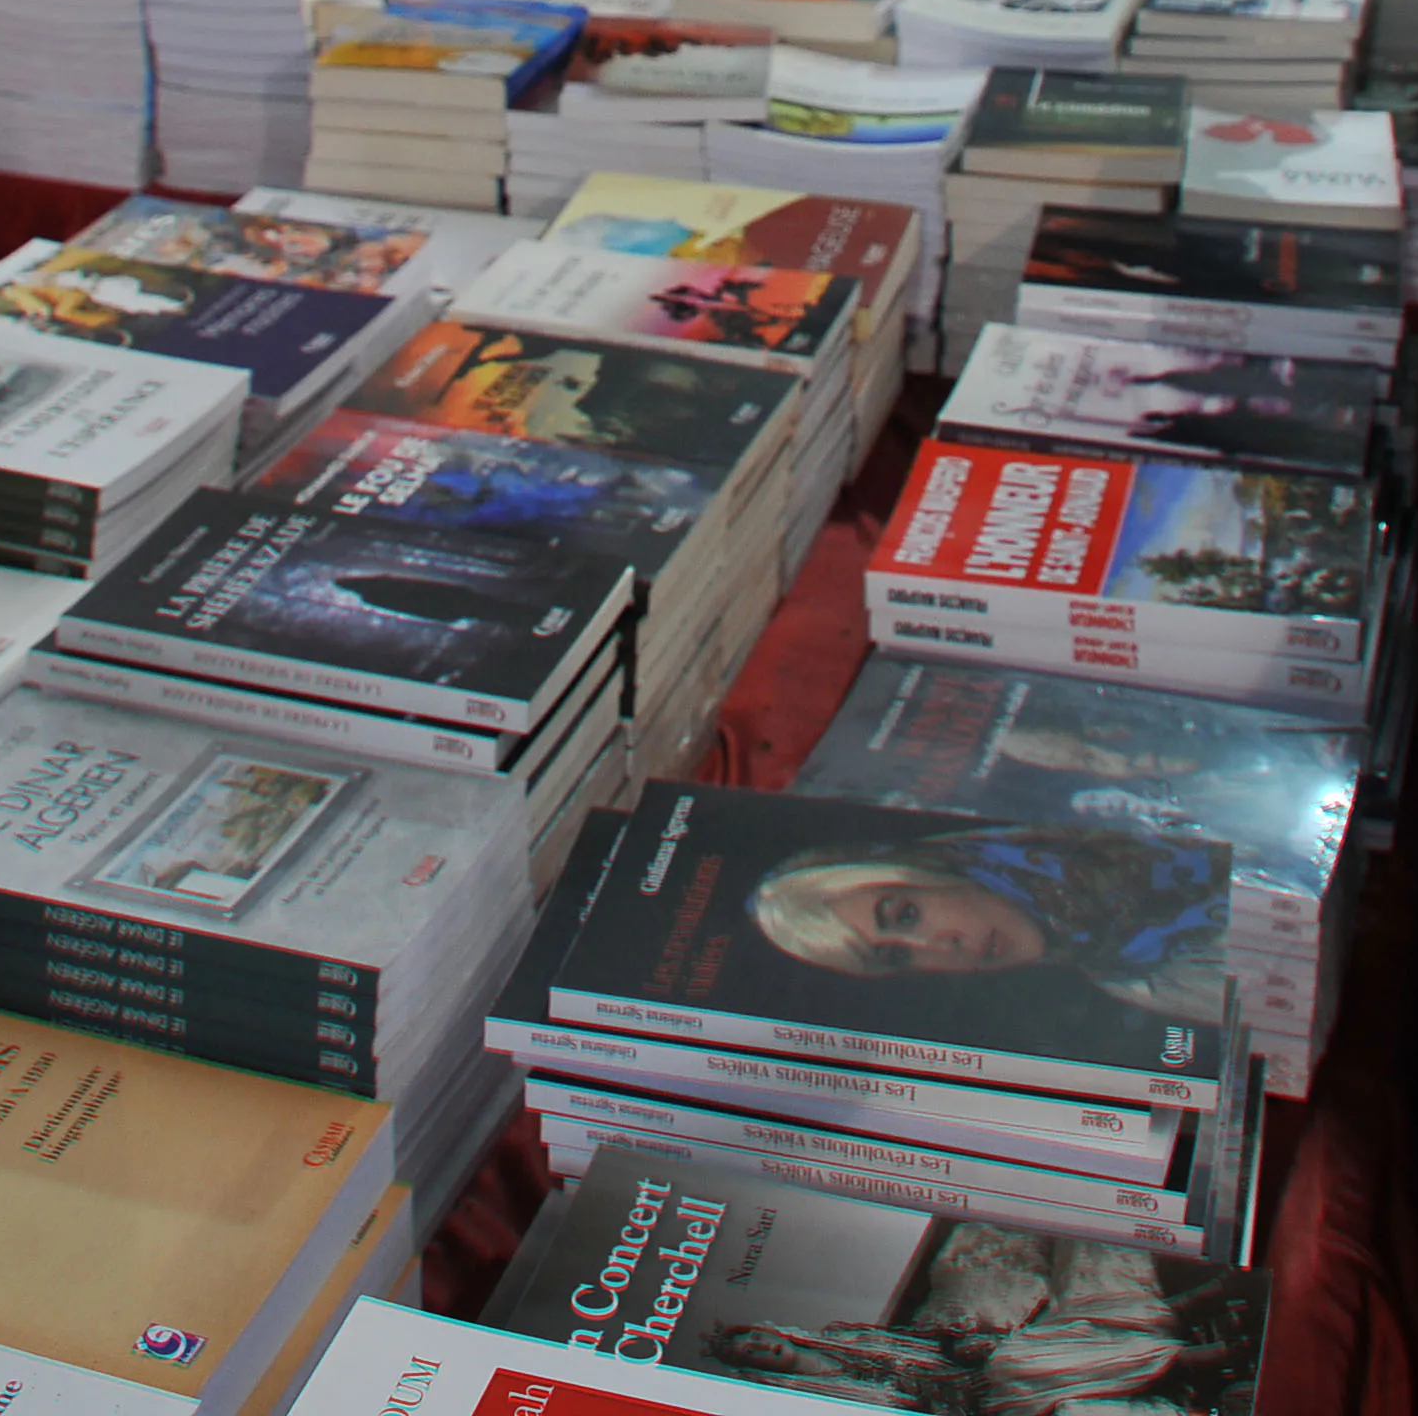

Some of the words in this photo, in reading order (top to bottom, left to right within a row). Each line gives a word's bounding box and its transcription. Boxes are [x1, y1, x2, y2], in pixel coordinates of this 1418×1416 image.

[963, 462, 1063, 579] L'HONNEUR
[773, 1024, 836, 1051] violées
[842, 1035, 949, 1066] révolutions
[706, 1054, 770, 1081] violées
[953, 1051, 986, 1072] Les
[776, 1065, 882, 1096] révolutions
[884, 1082, 918, 1103] Les
[21, 1065, 102, 1153] Dictionnaire
[38, 1070, 124, 1164] biographique
[303, 1121, 347, 1167] CASBAH
[743, 1123, 806, 1151] violées
[812, 1137, 917, 1167] révolutions
[919, 1156, 952, 1176] Les
[828, 1171, 934, 1201] révolutions
[936, 1190, 970, 1211] Les
[572, 1178, 672, 1321] Concert
[727, 1247, 763, 1290] Nora
[752, 1206, 778, 1249] Sari
[615, 1196, 728, 1365] Cherchell
